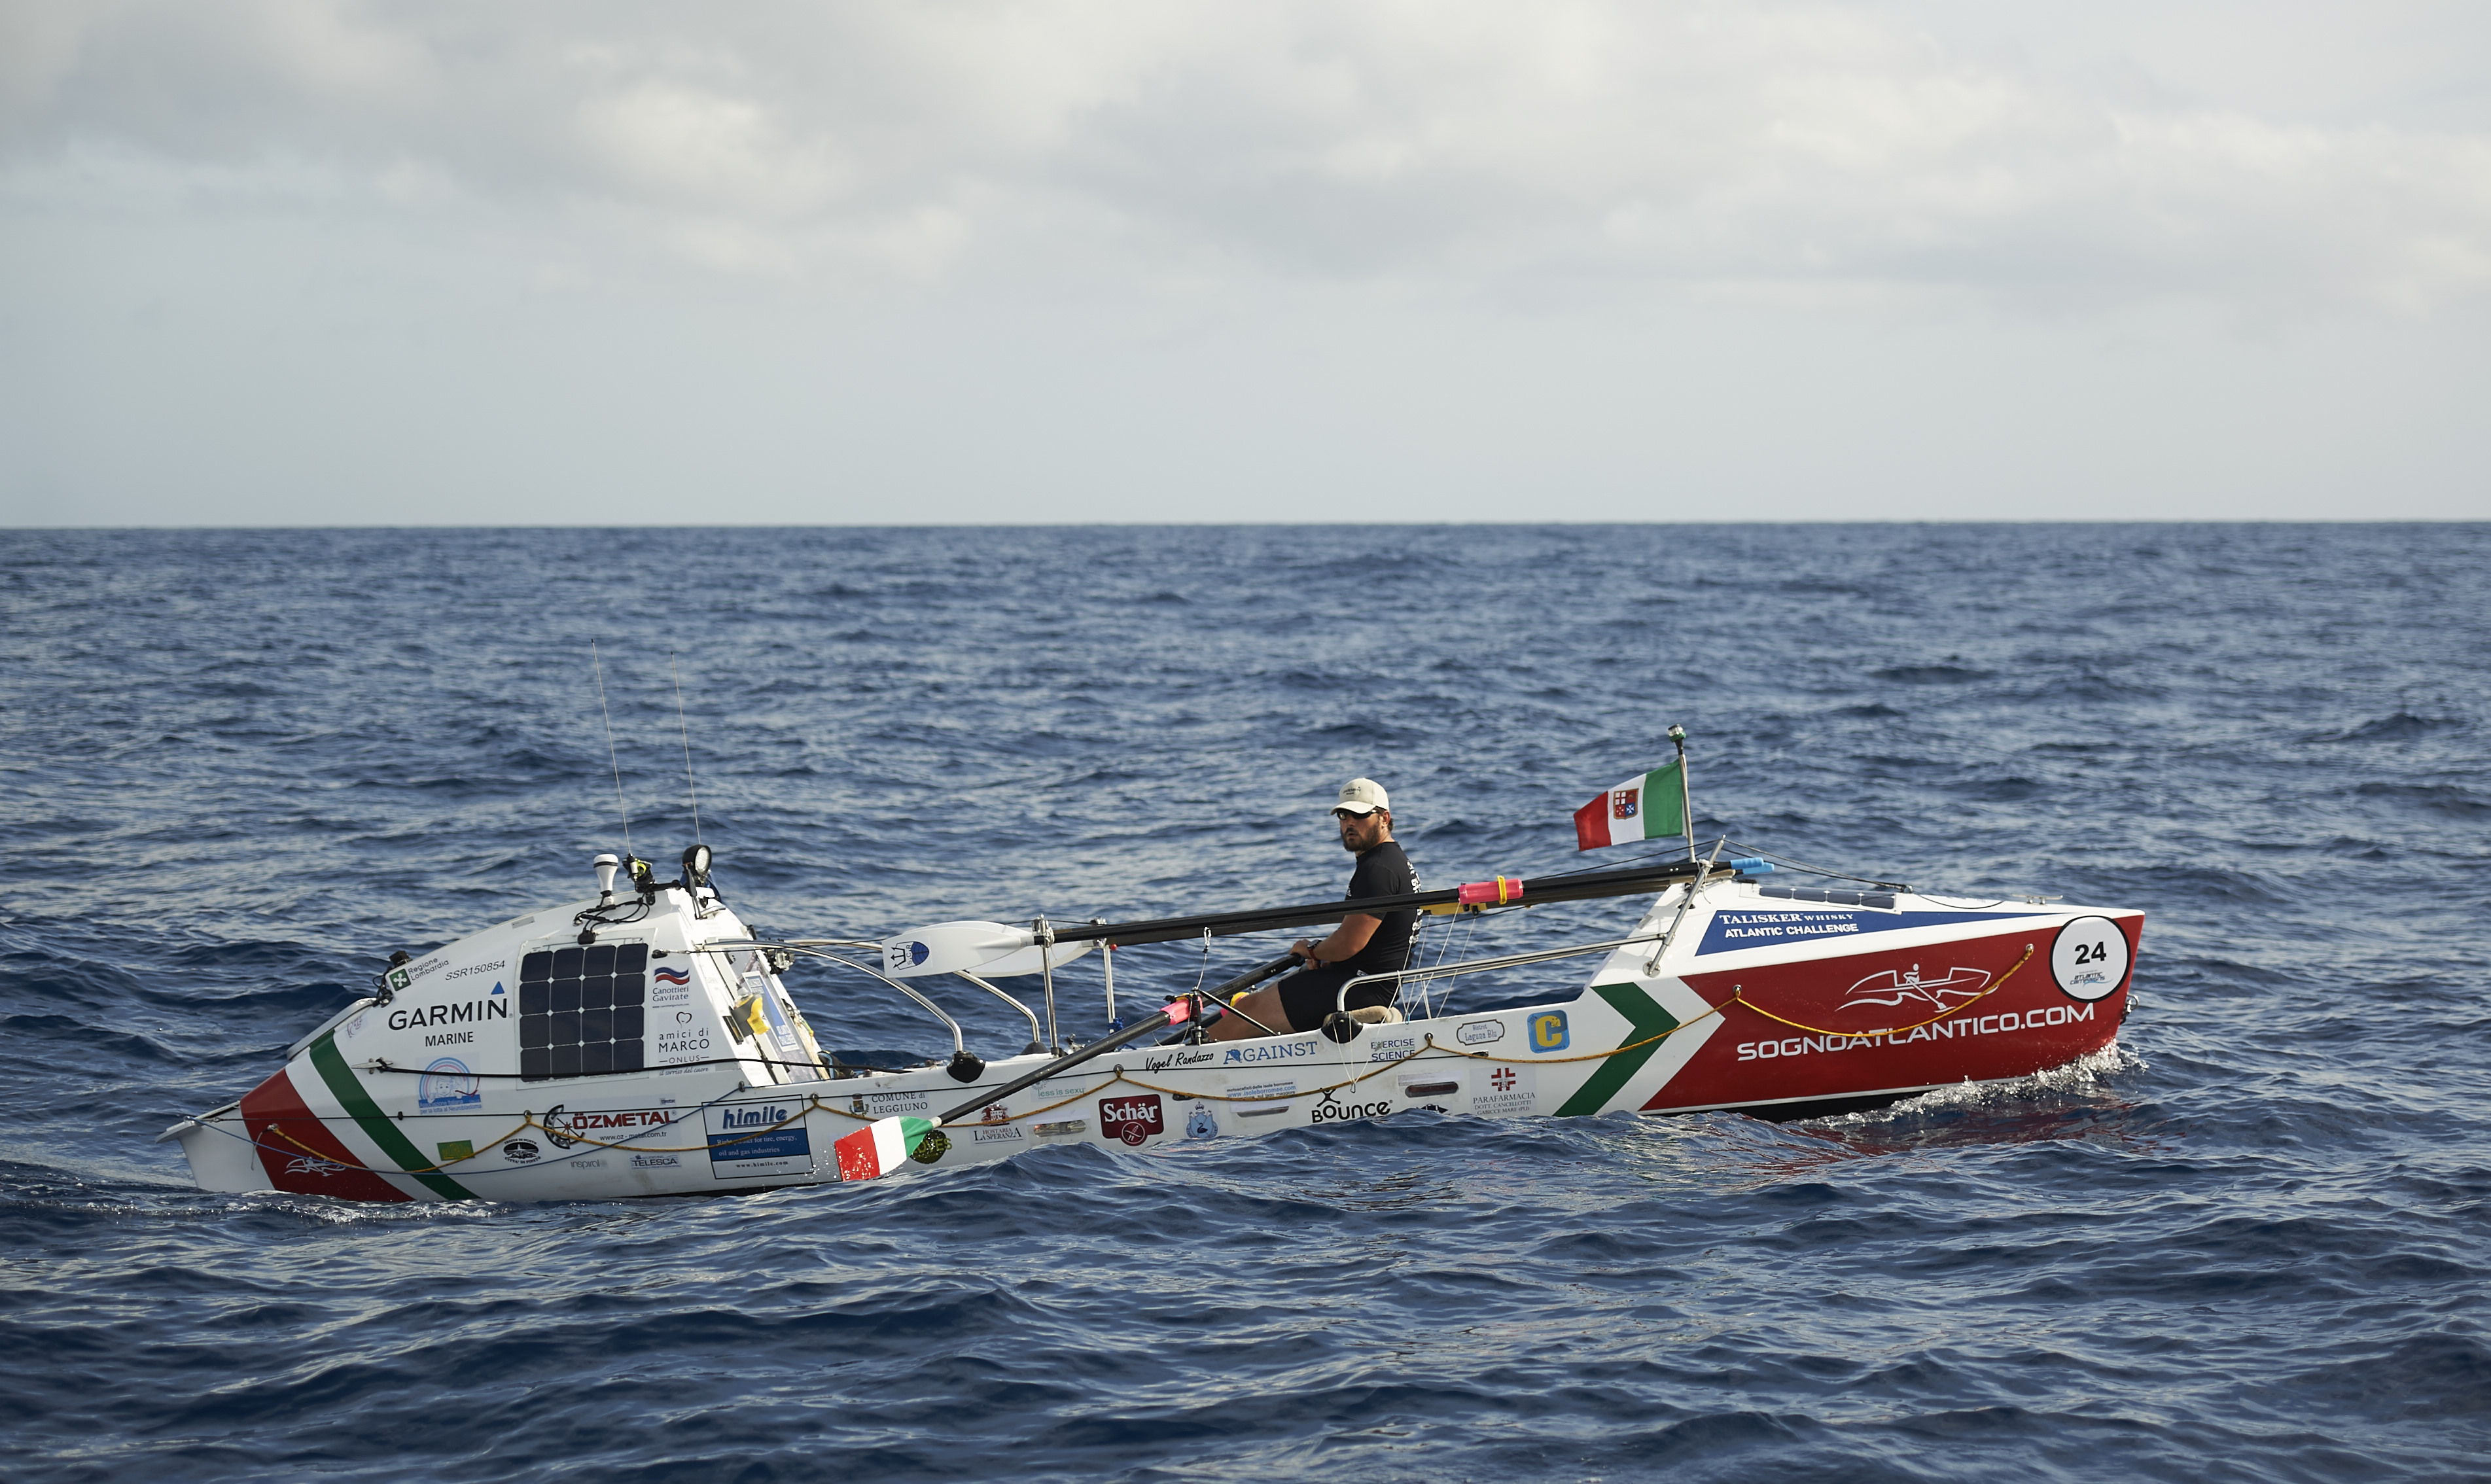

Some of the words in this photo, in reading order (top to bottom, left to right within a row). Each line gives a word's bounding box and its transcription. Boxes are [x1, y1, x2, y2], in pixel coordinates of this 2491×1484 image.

[1719, 913, 1802, 925] TALISKER
[1725, 927, 1783, 938] ATLANTIC
[1786, 923, 1859, 935] CHALLENGE
[2075, 941, 2106, 964] 24
[408, 958, 438, 974] Regione
[411, 960, 449, 981] Lombardia
[446, 961, 505, 981] SSR150854
[652, 986, 689, 995] Canottieri
[652, 993, 688, 1002] Gavirate
[389, 998, 508, 1031] GARMIN
[659, 1029, 691, 1040] amici
[698, 1028, 709, 1036] di
[1465, 1033, 1486, 1042] Laguna
[1487, 1029, 1497, 1038] Blu
[1536, 1016, 1563, 1047] C
[1737, 1003, 2094, 1061] SOGNOATLANTICO.COM
[425, 1031, 474, 1047] MARINE
[659, 1039, 709, 1053] MARCO
[669, 1055, 700, 1064] ONLUS
[1224, 1041, 1318, 1065] AGAINST
[1371, 1050, 1415, 1061] SCIENCE
[1146, 1054, 1173, 1074] Vogel
[1175, 1051, 1214, 1066] Randazzo
[872, 1092, 916, 1103] COMUNE
[1473, 1092, 1536, 1104] PARAFARMACIA
[874, 1102, 928, 1114] LEGGIUNO
[1103, 1102, 1158, 1123] Schär
[572, 1111, 679, 1129] ÖZMETAL
[723, 1106, 787, 1129] himile
[974, 1130, 986, 1141] LA
[987, 1127, 1022, 1140] SPERANZA
[570, 1159, 600, 1169] inspiral
[632, 1158, 677, 1167] TELESCA
